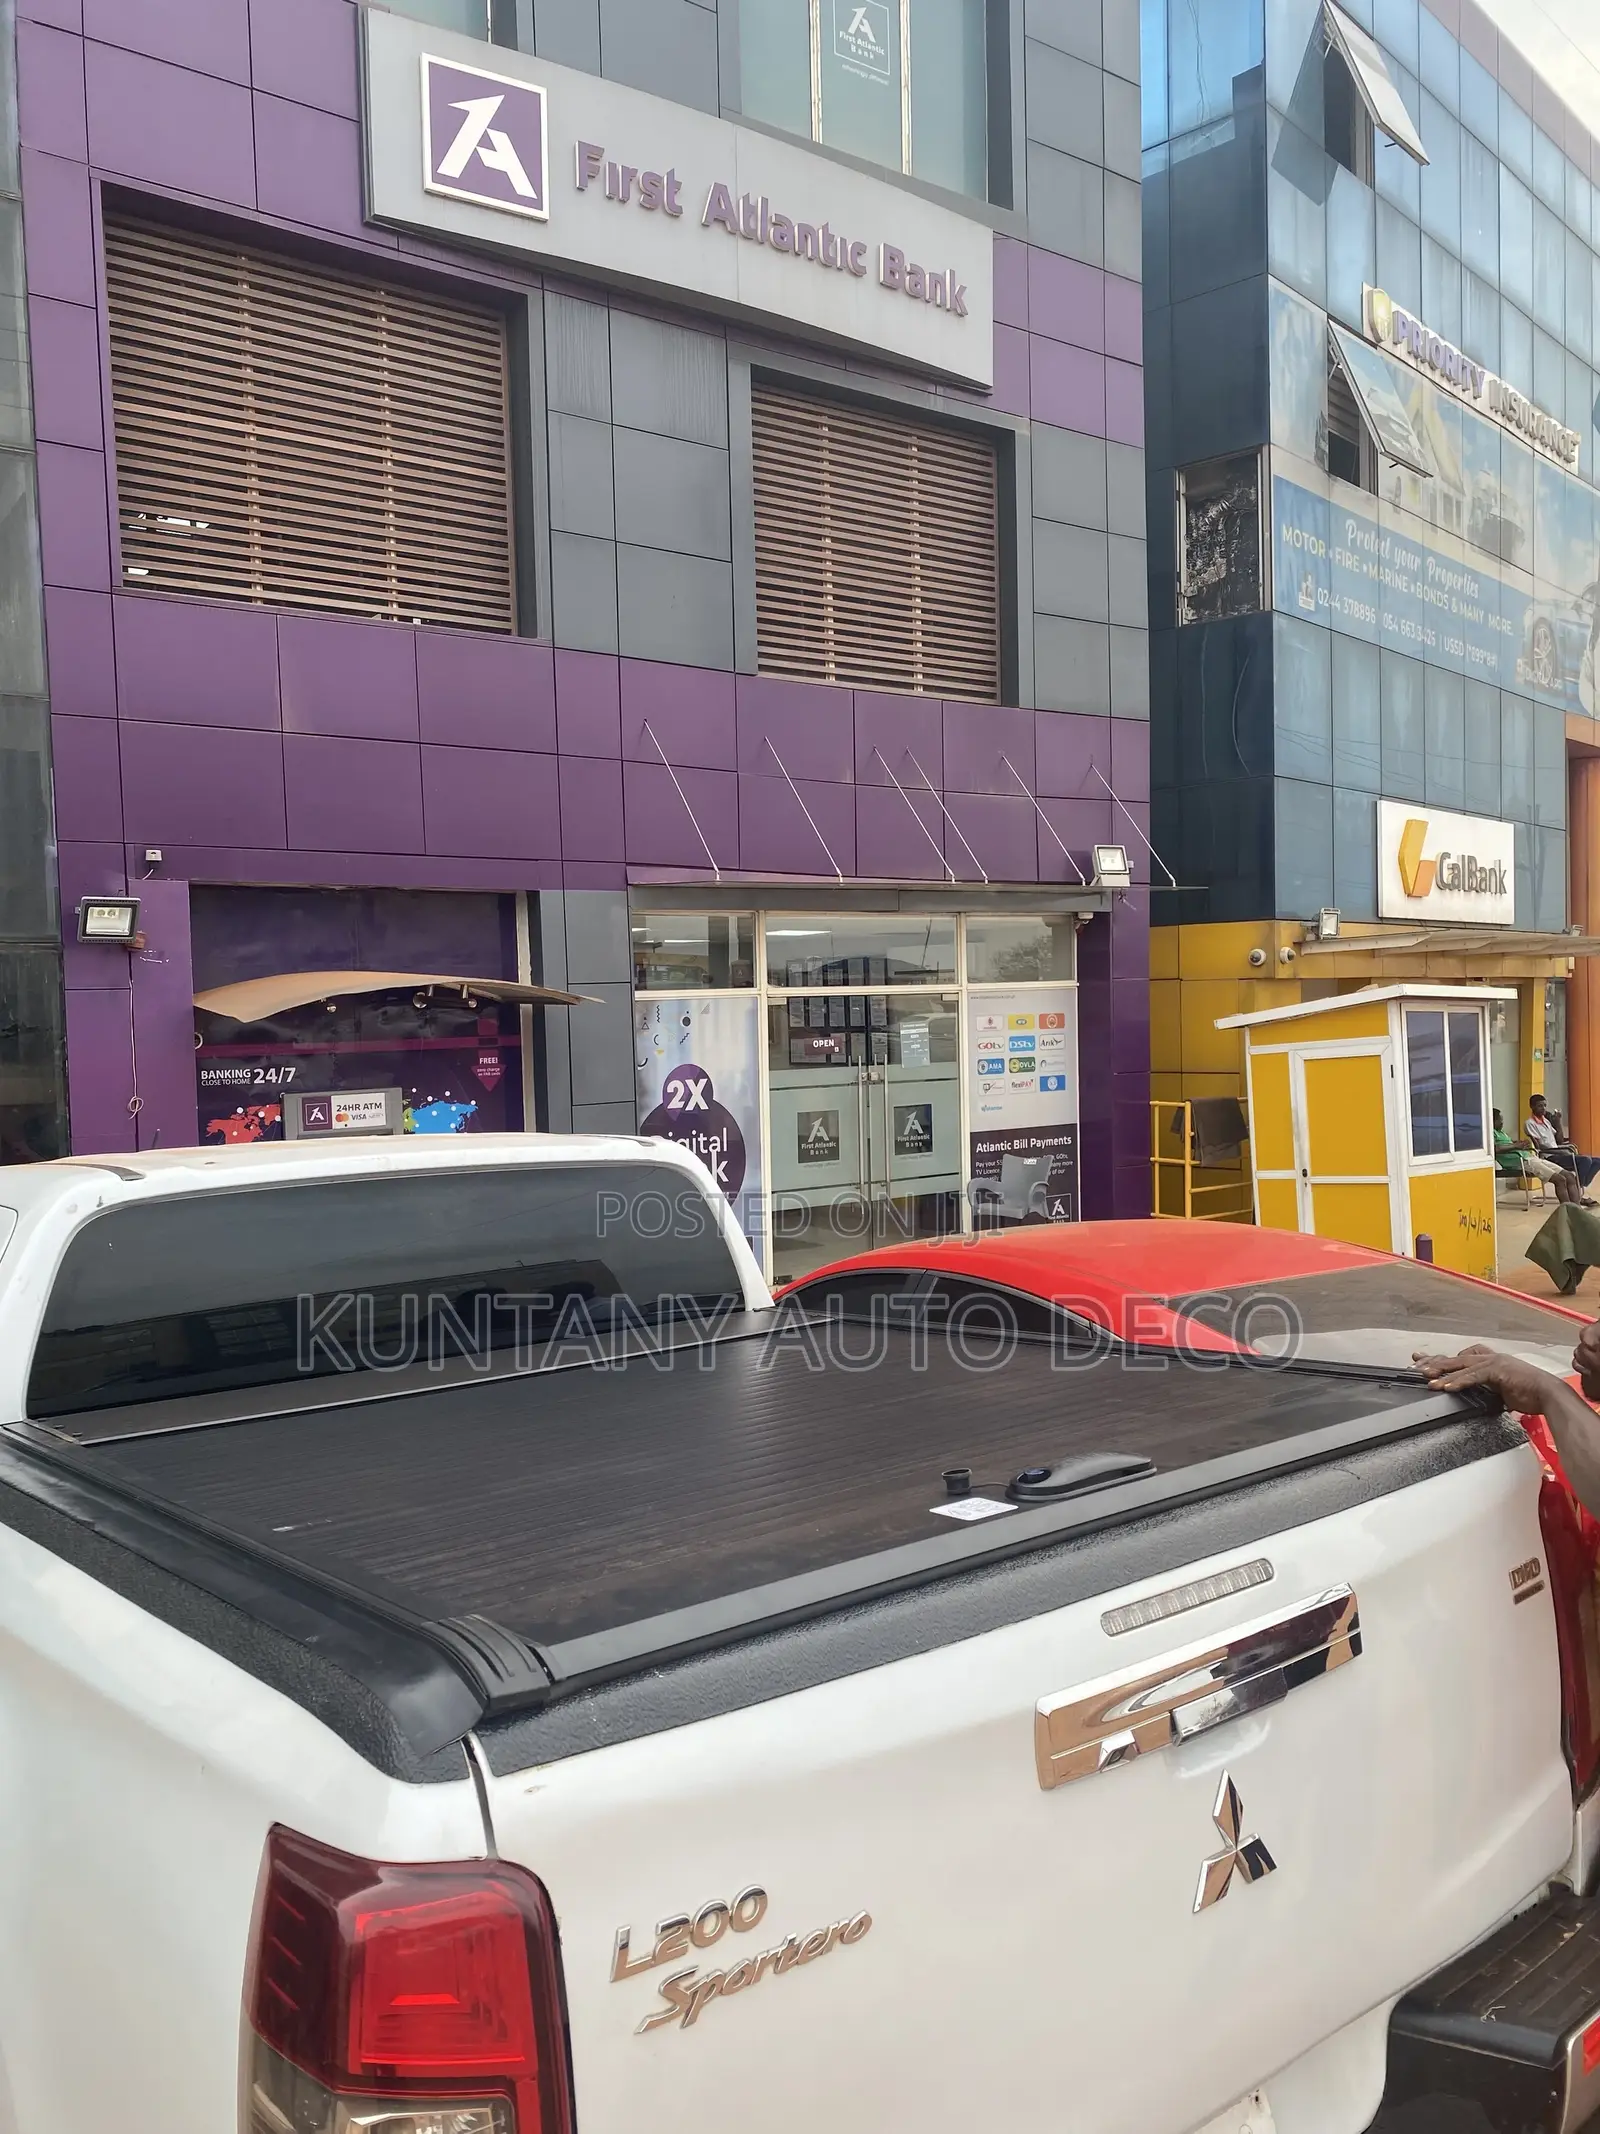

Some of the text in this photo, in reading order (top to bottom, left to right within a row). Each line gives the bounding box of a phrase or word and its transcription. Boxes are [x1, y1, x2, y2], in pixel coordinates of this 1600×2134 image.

[857, 38, 885, 55] Atlantic
[575, 141, 968, 317] First Atlantic Bank
[1392, 310, 1577, 464] PRIORITY INSURANCE
[1282, 523, 1326, 559] MOTOR
[1335, 546, 1360, 573] FIRE
[1368, 561, 1409, 594] MARINE
[1416, 582, 1449, 610] BONDS
[1460, 601, 1485, 625] MANY
[1345, 519, 1479, 599] Protect your Properties
[1444, 636, 1464, 657] USSD
[1436, 851, 1507, 896] CalBank
[813, 1039, 835, 1048] OPEN
[201, 1066, 297, 1084] BANKING 24/7
[336, 1102, 382, 1112] 24HR ATM
[666, 1078, 709, 1112] 2X
[814, 1141, 836, 1149] Atlantic
[976, 1136, 1072, 1153] Atlantic Bill Payments
[609, 1884, 768, 1983] L200
[634, 1909, 873, 2035] Sportero
